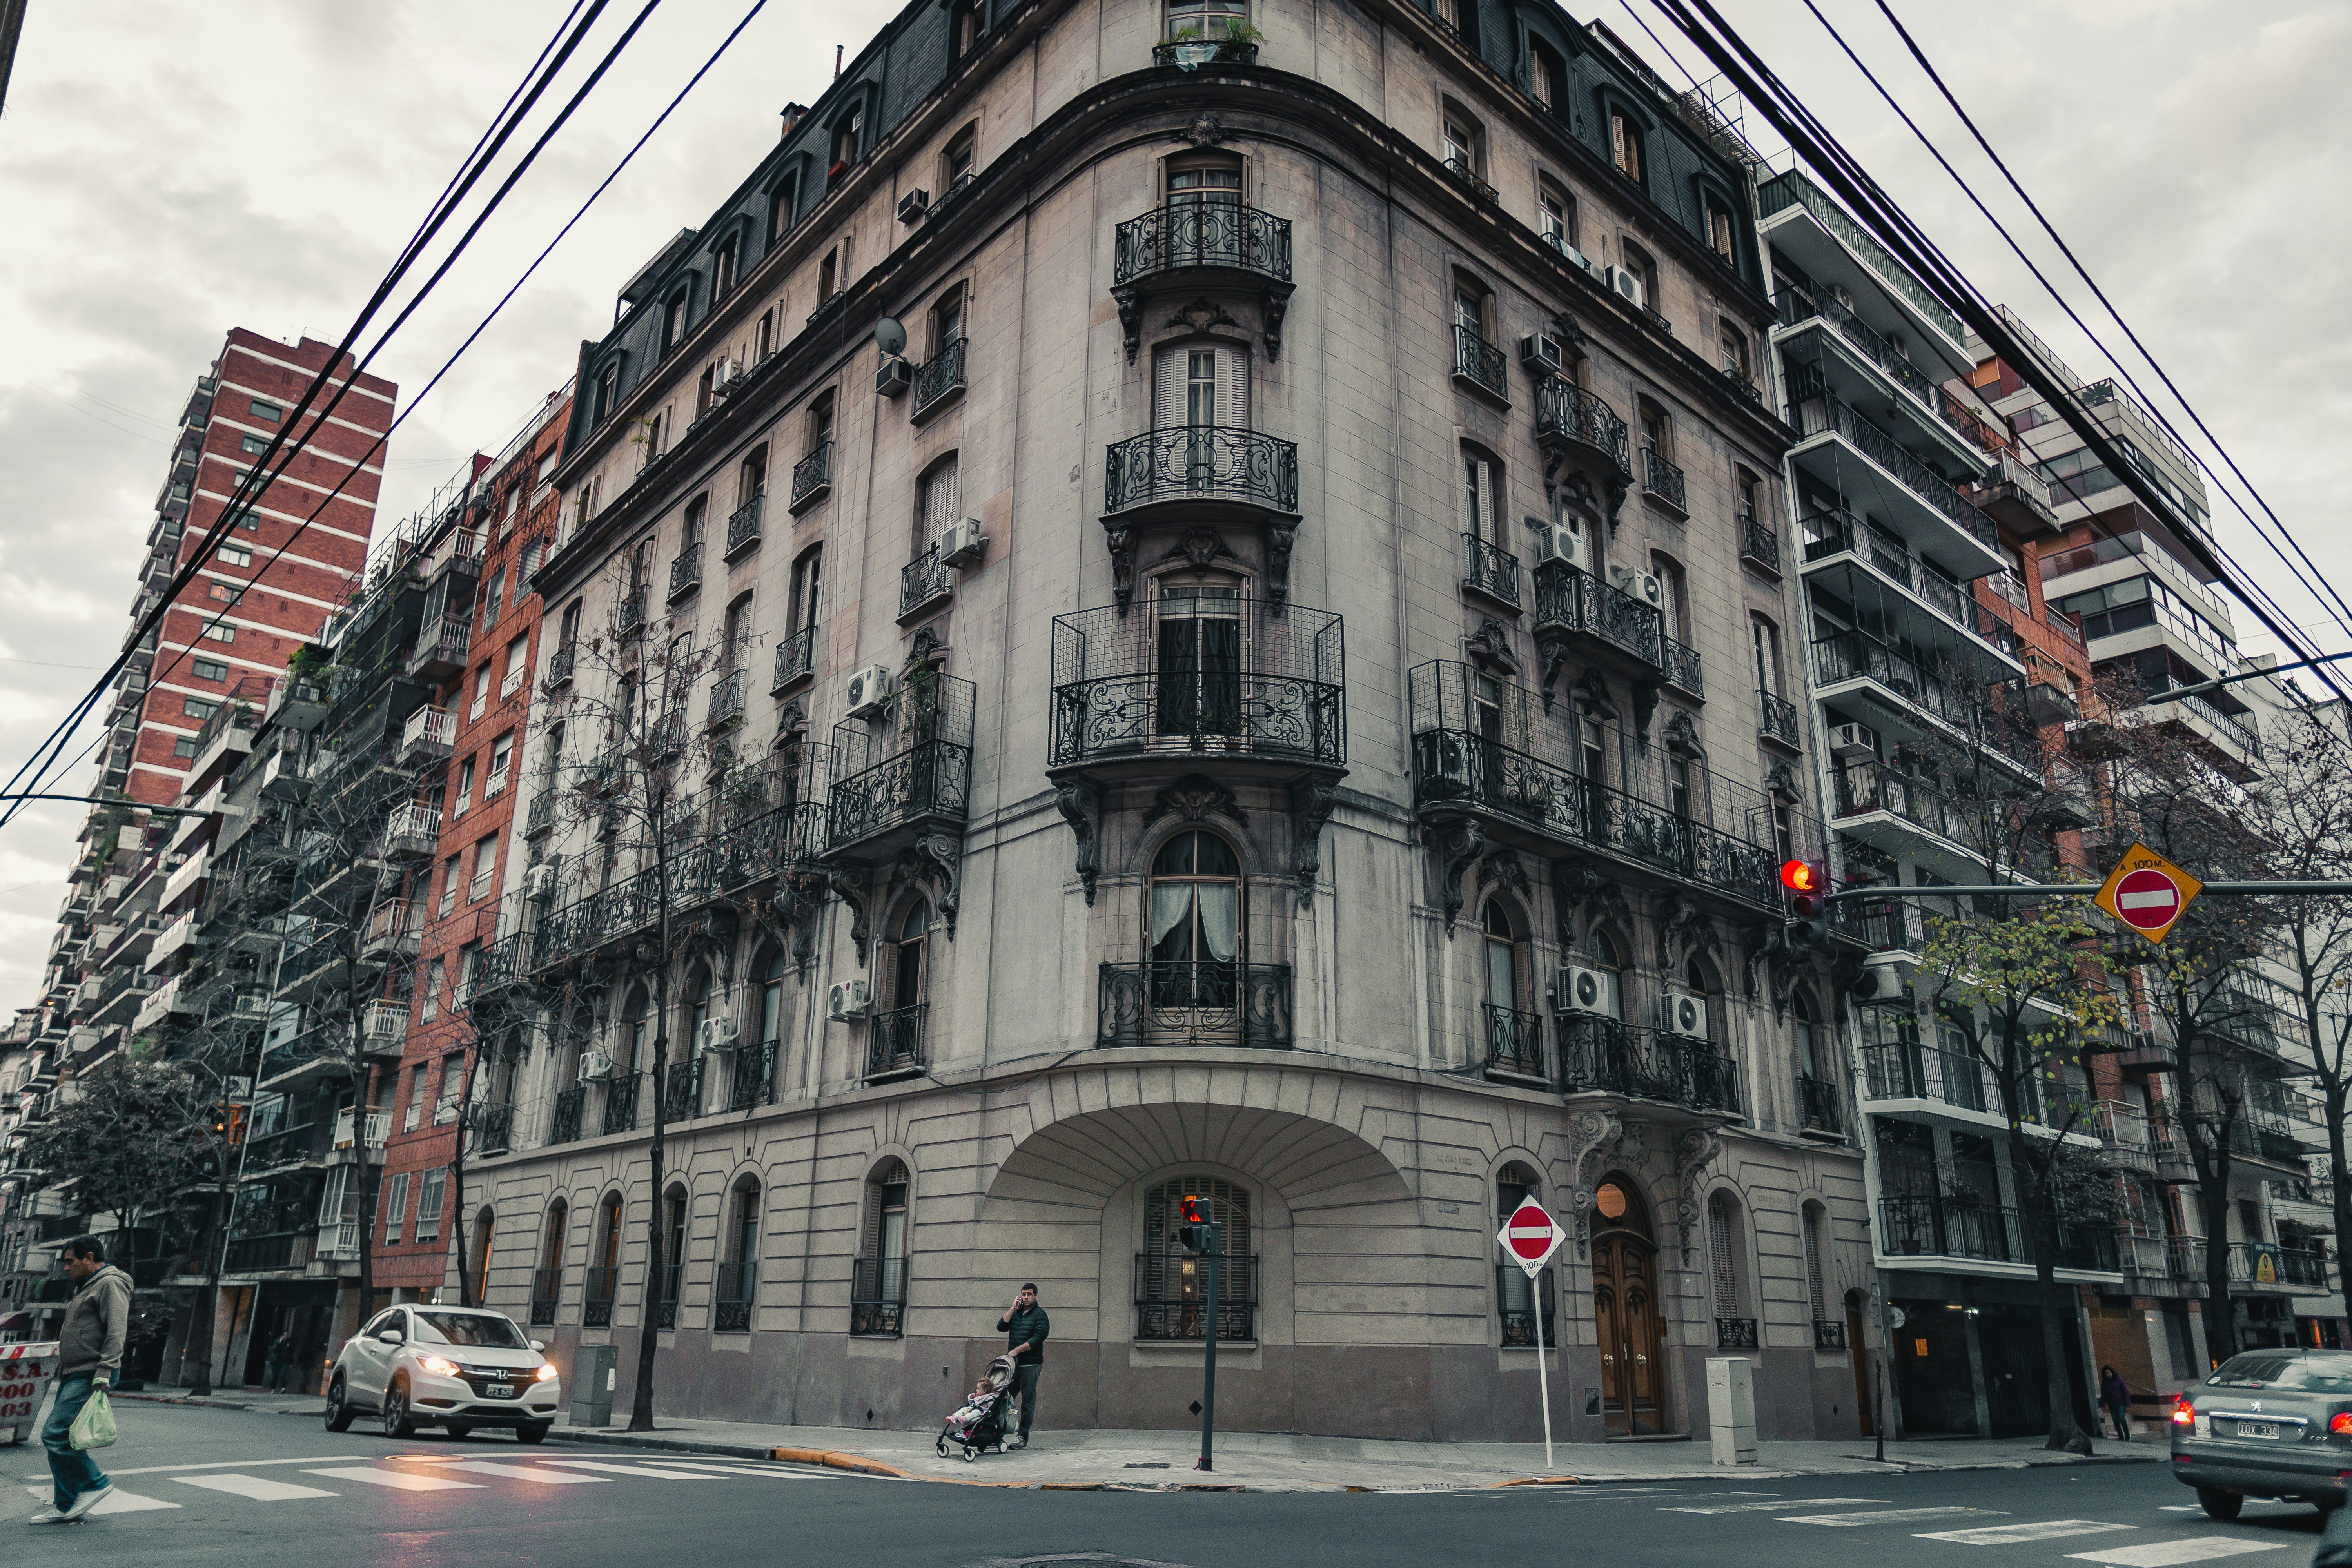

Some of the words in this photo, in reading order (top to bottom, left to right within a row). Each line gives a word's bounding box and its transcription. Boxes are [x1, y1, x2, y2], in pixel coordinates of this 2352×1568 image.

[2, 1361, 49, 1381] S.A.
[0, 1382, 35, 1400] 00
[0, 1401, 32, 1418] 03
[2239, 1424, 2256, 1434] IOX
[2261, 1426, 2278, 1436] 334
